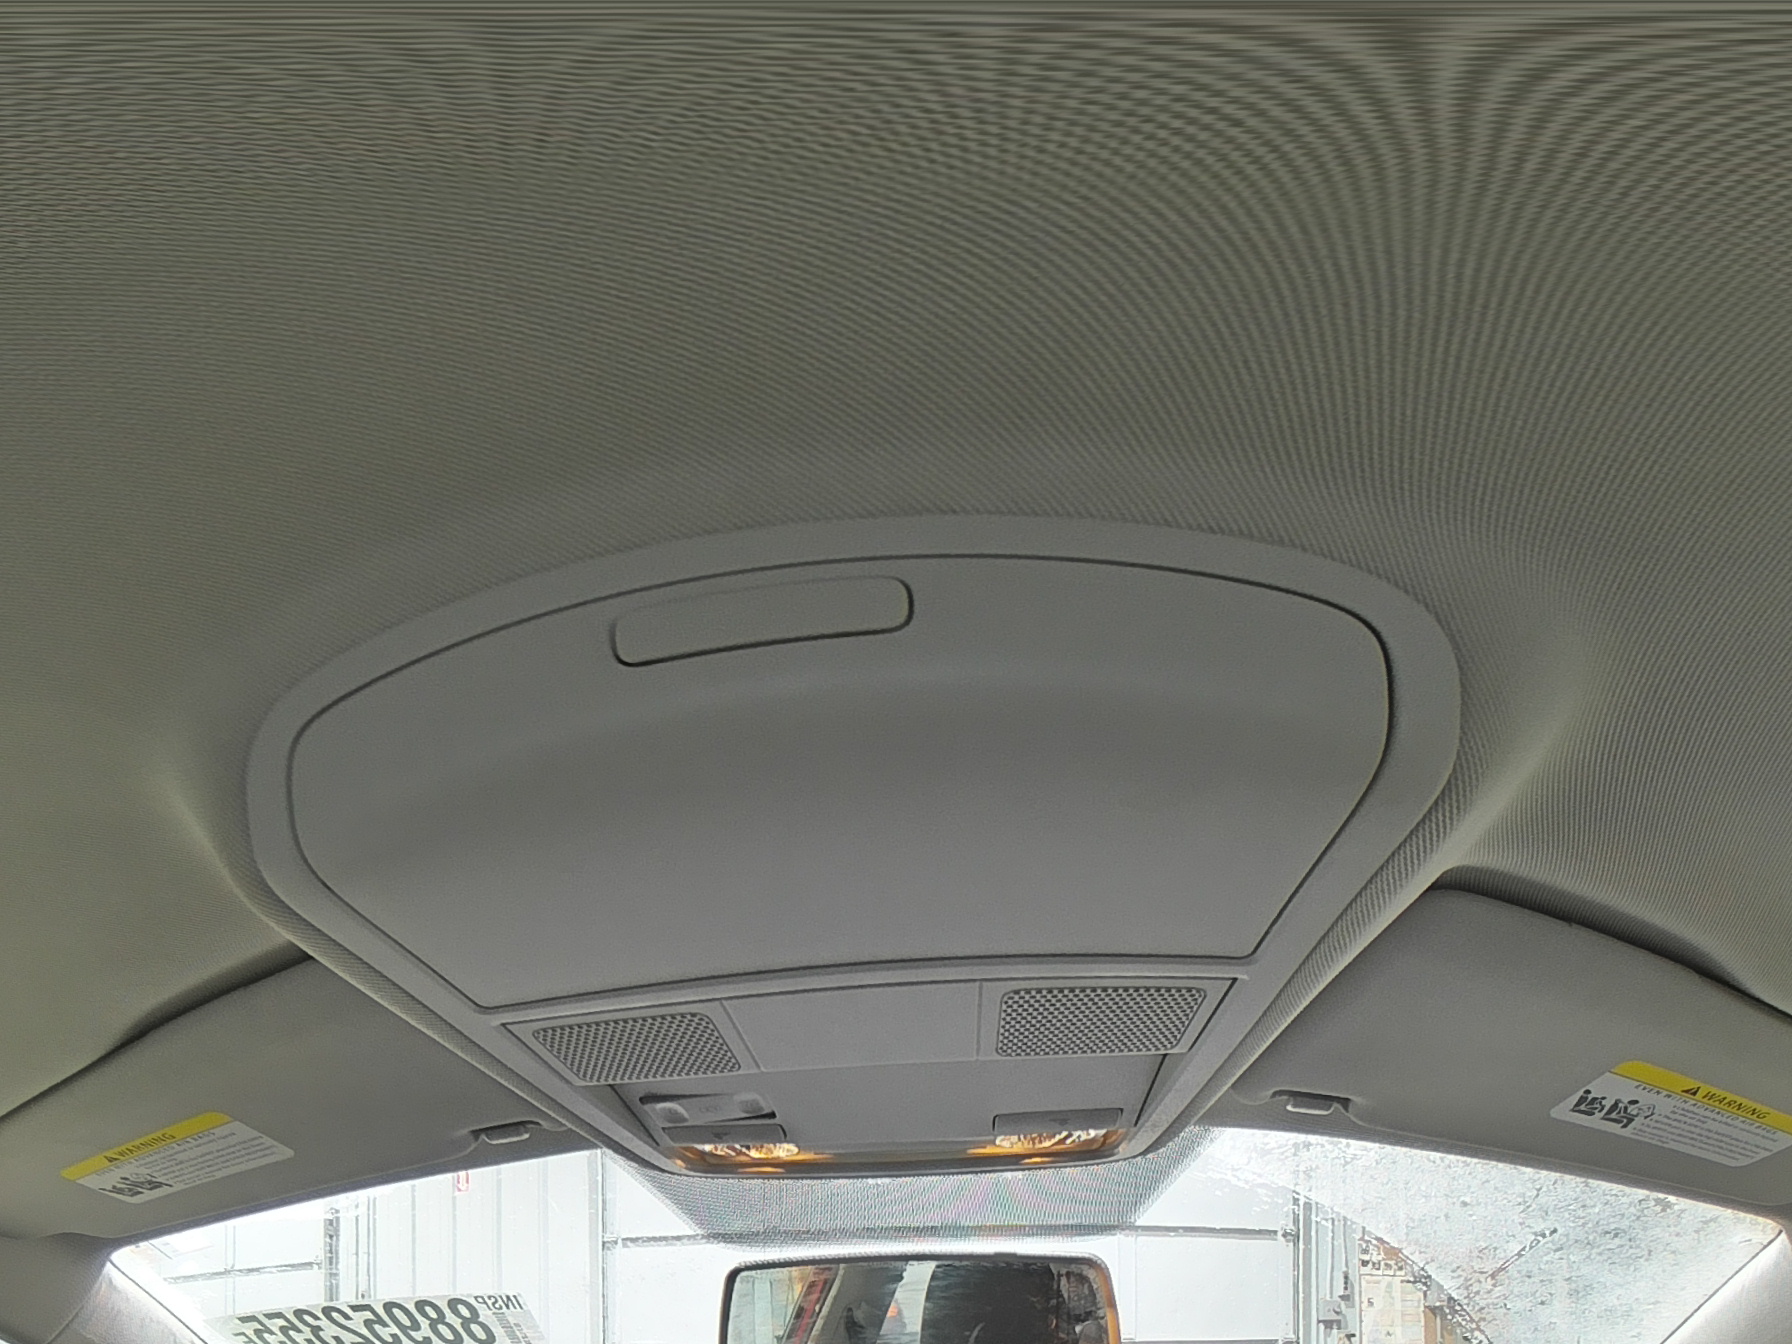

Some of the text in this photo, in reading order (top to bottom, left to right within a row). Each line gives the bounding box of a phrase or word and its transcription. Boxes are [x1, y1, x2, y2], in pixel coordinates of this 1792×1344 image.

[1634, 1083, 1663, 1096] EVEN
[1663, 1092, 1690, 1105] WITH
[1691, 1102, 1739, 1121] ADVANCED
[1702, 1090, 1771, 1120] WARNING
[116, 1132, 177, 1159] WARNING
